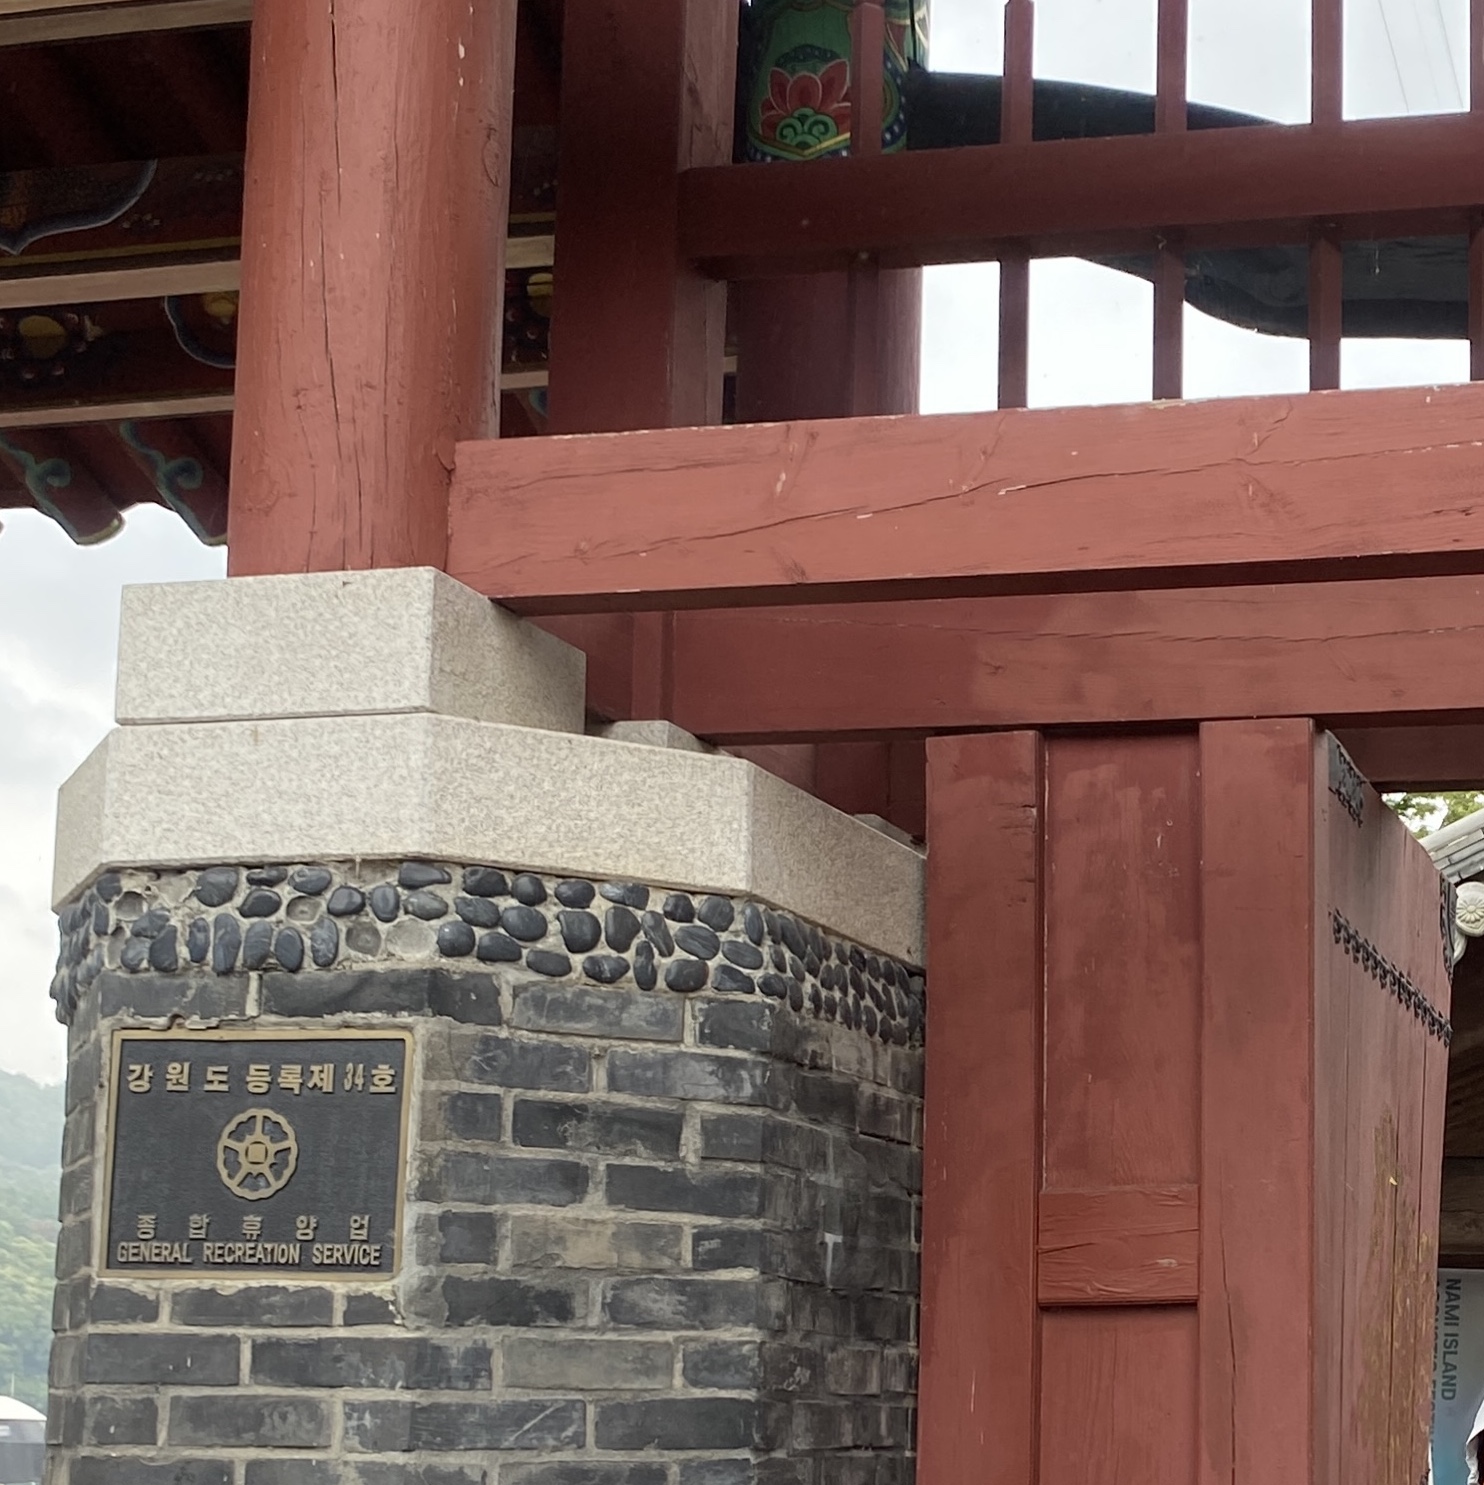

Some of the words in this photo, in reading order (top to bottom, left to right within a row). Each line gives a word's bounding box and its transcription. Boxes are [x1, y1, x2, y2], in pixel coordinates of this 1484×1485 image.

[117, 1243, 193, 1264] GENERAL
[203, 1243, 301, 1265] RECREATION
[312, 1244, 382, 1266] SERVICE
[1444, 1278, 1462, 1327] NAMI
[1441, 1333, 1460, 1401] ISLAND
